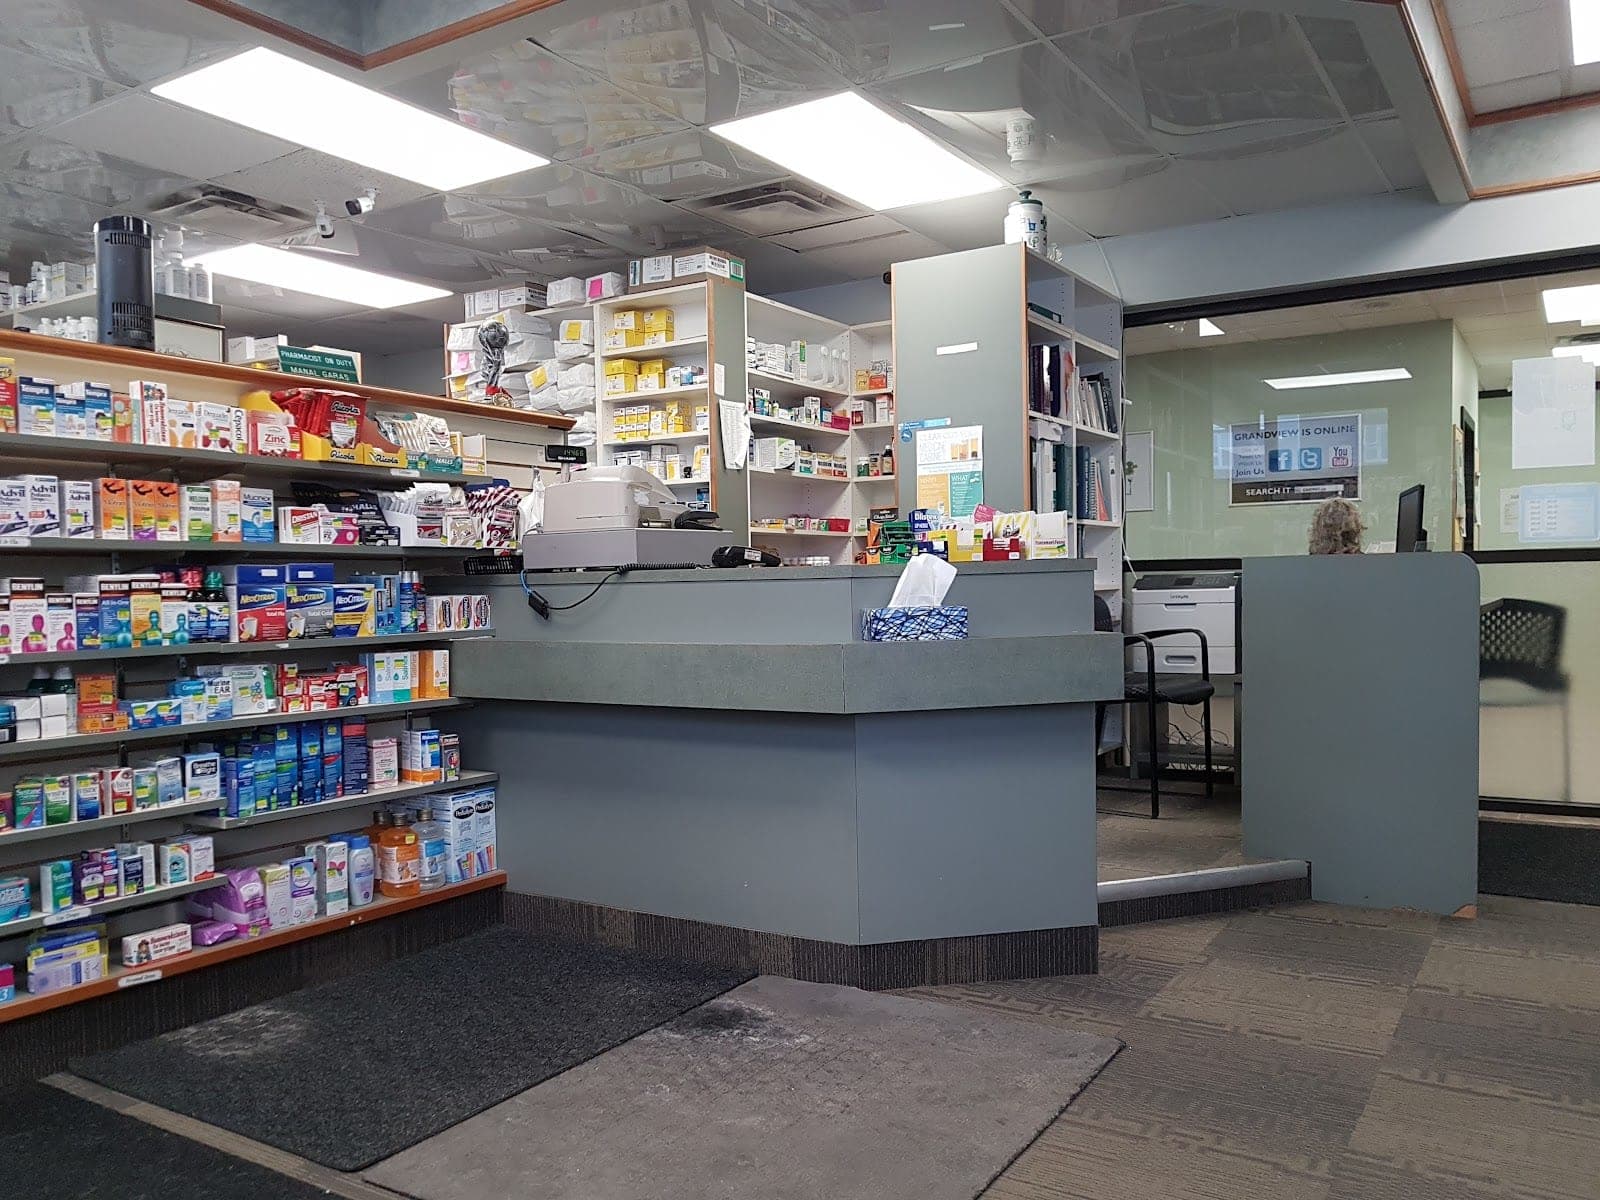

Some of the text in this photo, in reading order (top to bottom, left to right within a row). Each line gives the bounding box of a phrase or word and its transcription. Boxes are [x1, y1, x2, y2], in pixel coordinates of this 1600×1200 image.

[280, 350, 321, 362] PHARMACIST
[336, 359, 352, 367] DUTY
[290, 366, 349, 381] MANAL GARAS
[331, 402, 360, 414] Ricola
[233, 409, 244, 441] Cepacol
[1234, 425, 1356, 440] GRANDVIEW IS ONLINE
[265, 434, 286, 444] Zinc
[330, 450, 355, 460] Ricola
[1333, 446, 1348, 456] You
[375, 453, 398, 464] Ricola
[1236, 469, 1251, 477] Join
[31, 485, 56, 493] Advil
[1246, 487, 1280, 496] SEARCH
